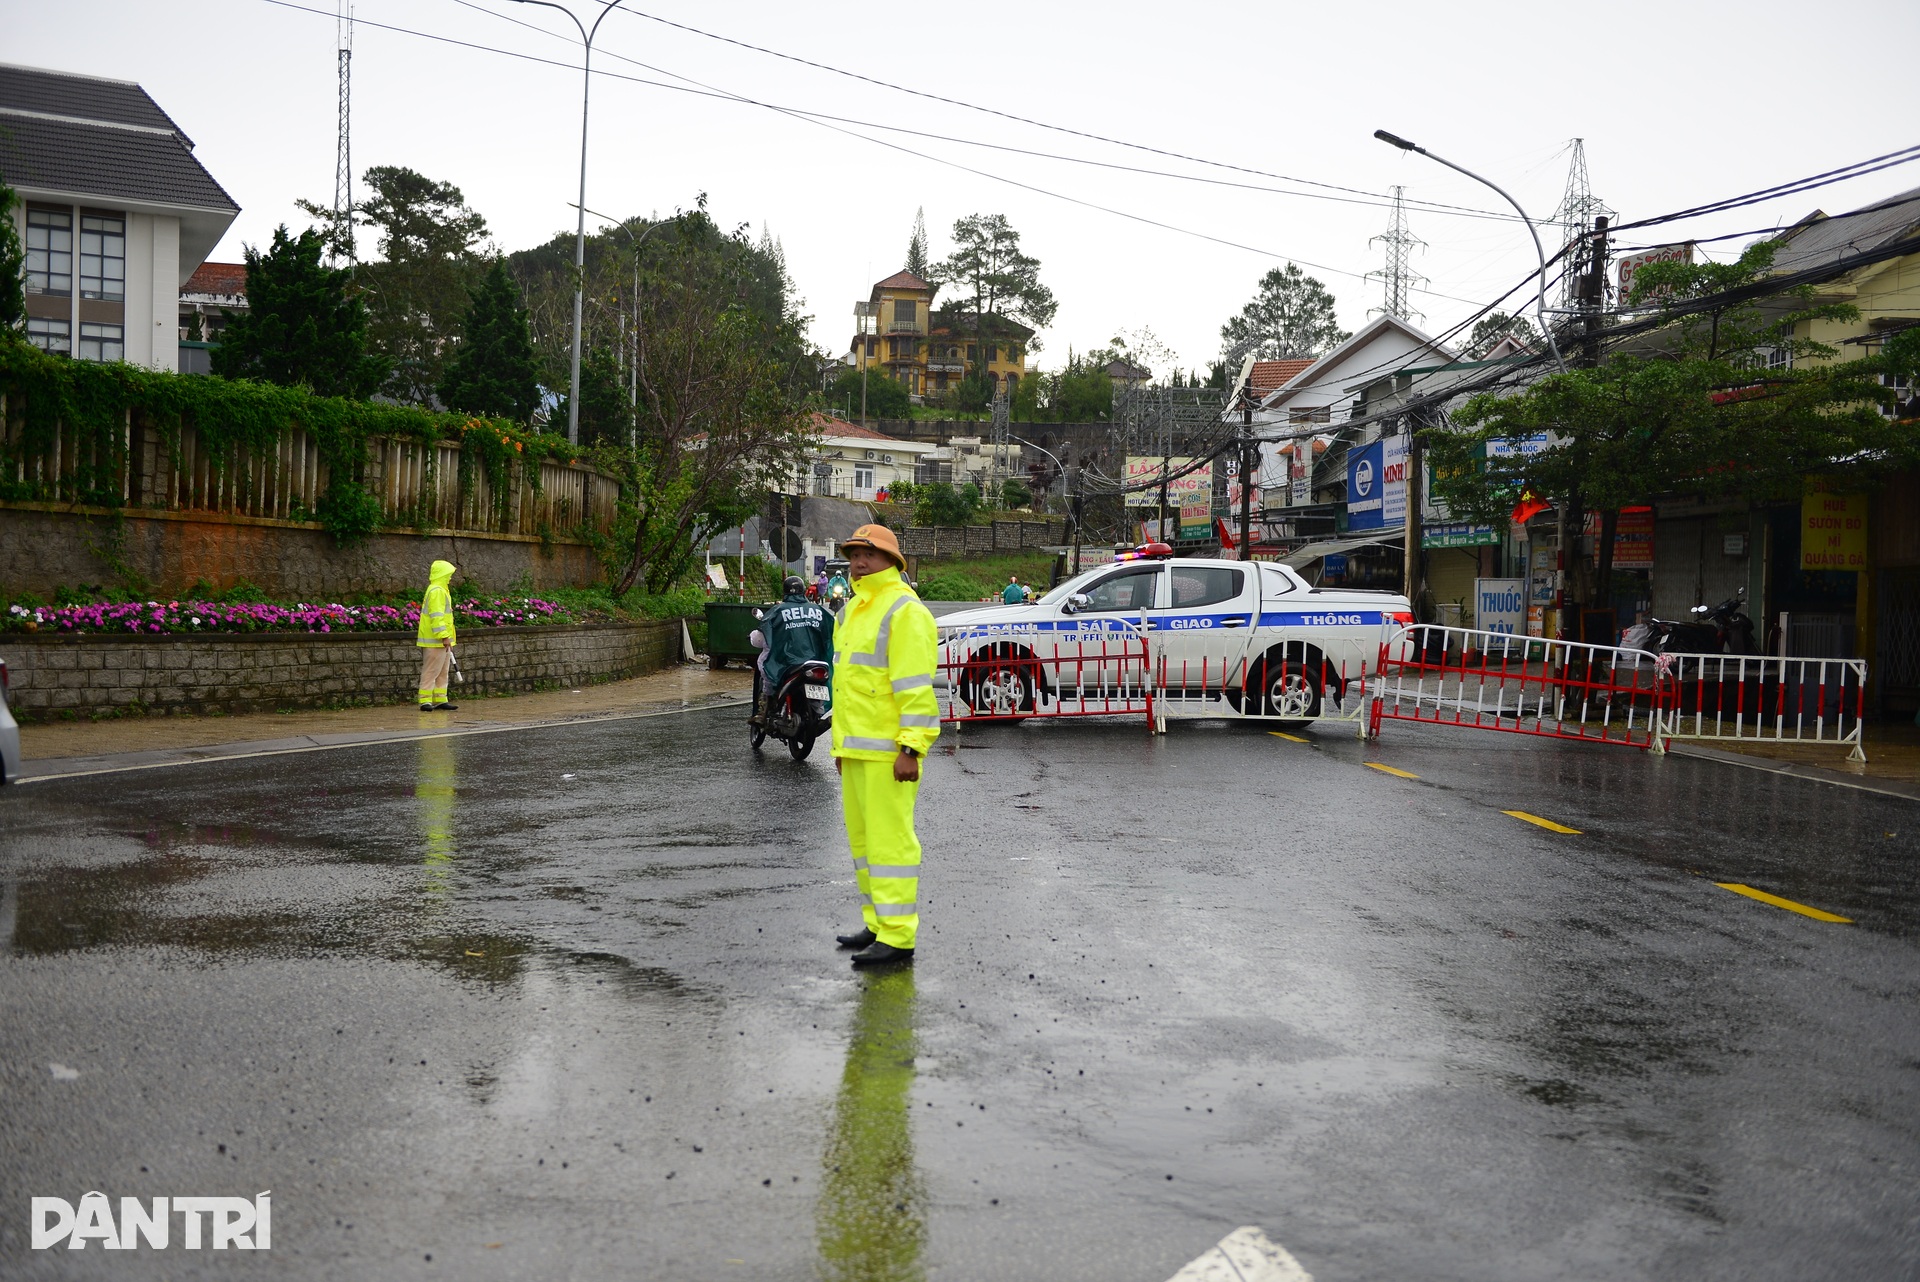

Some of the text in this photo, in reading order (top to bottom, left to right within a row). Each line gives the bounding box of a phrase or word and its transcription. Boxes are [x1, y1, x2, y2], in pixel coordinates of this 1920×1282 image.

[1482, 585, 1522, 613] THUỐC
[781, 606, 823, 622] RELAB
[1080, 620, 1113, 632] SÁT
[1170, 618, 1213, 629] GIAO
[1301, 613, 1362, 625] THÔNG
[1488, 619, 1514, 643] TÂY
